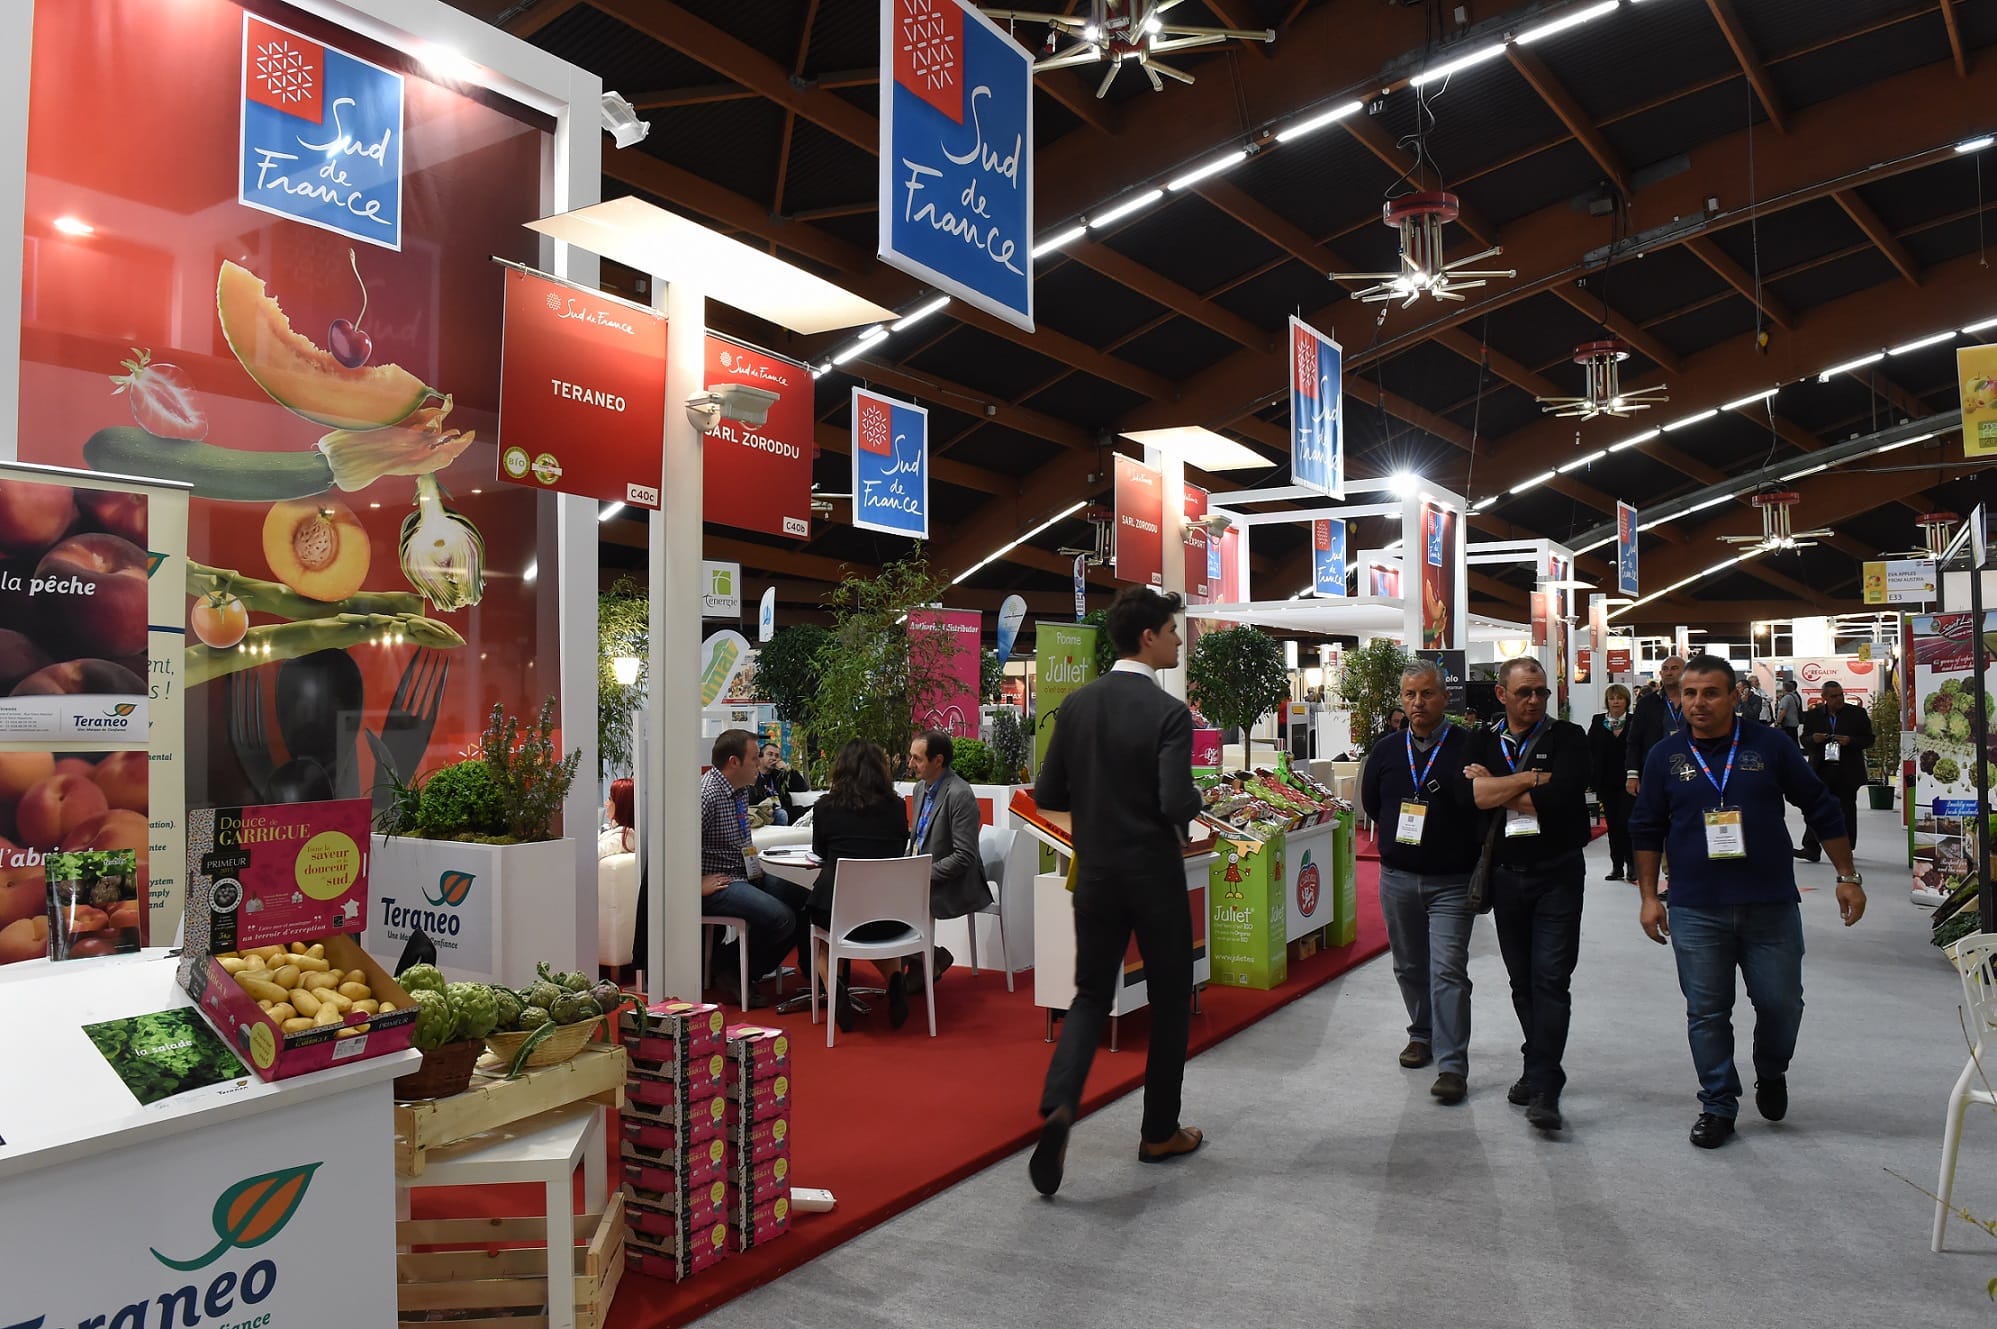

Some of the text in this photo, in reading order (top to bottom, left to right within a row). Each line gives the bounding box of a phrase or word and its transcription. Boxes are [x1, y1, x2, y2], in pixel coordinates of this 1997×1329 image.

[296, 97, 391, 167] Sud
[940, 85, 1022, 190] Sud
[254, 147, 392, 225] France
[319, 159, 352, 187] de
[961, 178, 991, 219] de
[902, 157, 1025, 276] France
[558, 299, 585, 318] Sud
[597, 311, 635, 335] France
[729, 355, 751, 375] Sud
[759, 367, 789, 387] France
[551, 379, 626, 413] TERANEO
[742, 432, 800, 460] ZORODDU
[880, 434, 922, 477] Sud
[630, 488, 655, 502] C40c
[863, 480, 923, 516] France
[890, 479, 905, 495] de
[786, 520, 806, 533] C40b
[1, 571, 97, 596] la pêche
[1045, 655, 1089, 684] Juliet
[73, 715, 128, 727] Teraneo
[219, 824, 311, 846] GARRIGUE
[220, 817, 266, 830] Douce
[207, 857, 247, 869] PRIMEUR
[311, 848, 350, 861] saveur
[304, 863, 349, 875] douceur
[381, 897, 460, 936] Teraneo
[1214, 905, 1252, 923] Juliet
[135, 1039, 193, 1057] la salade
[0, 1259, 278, 1329] aneo
